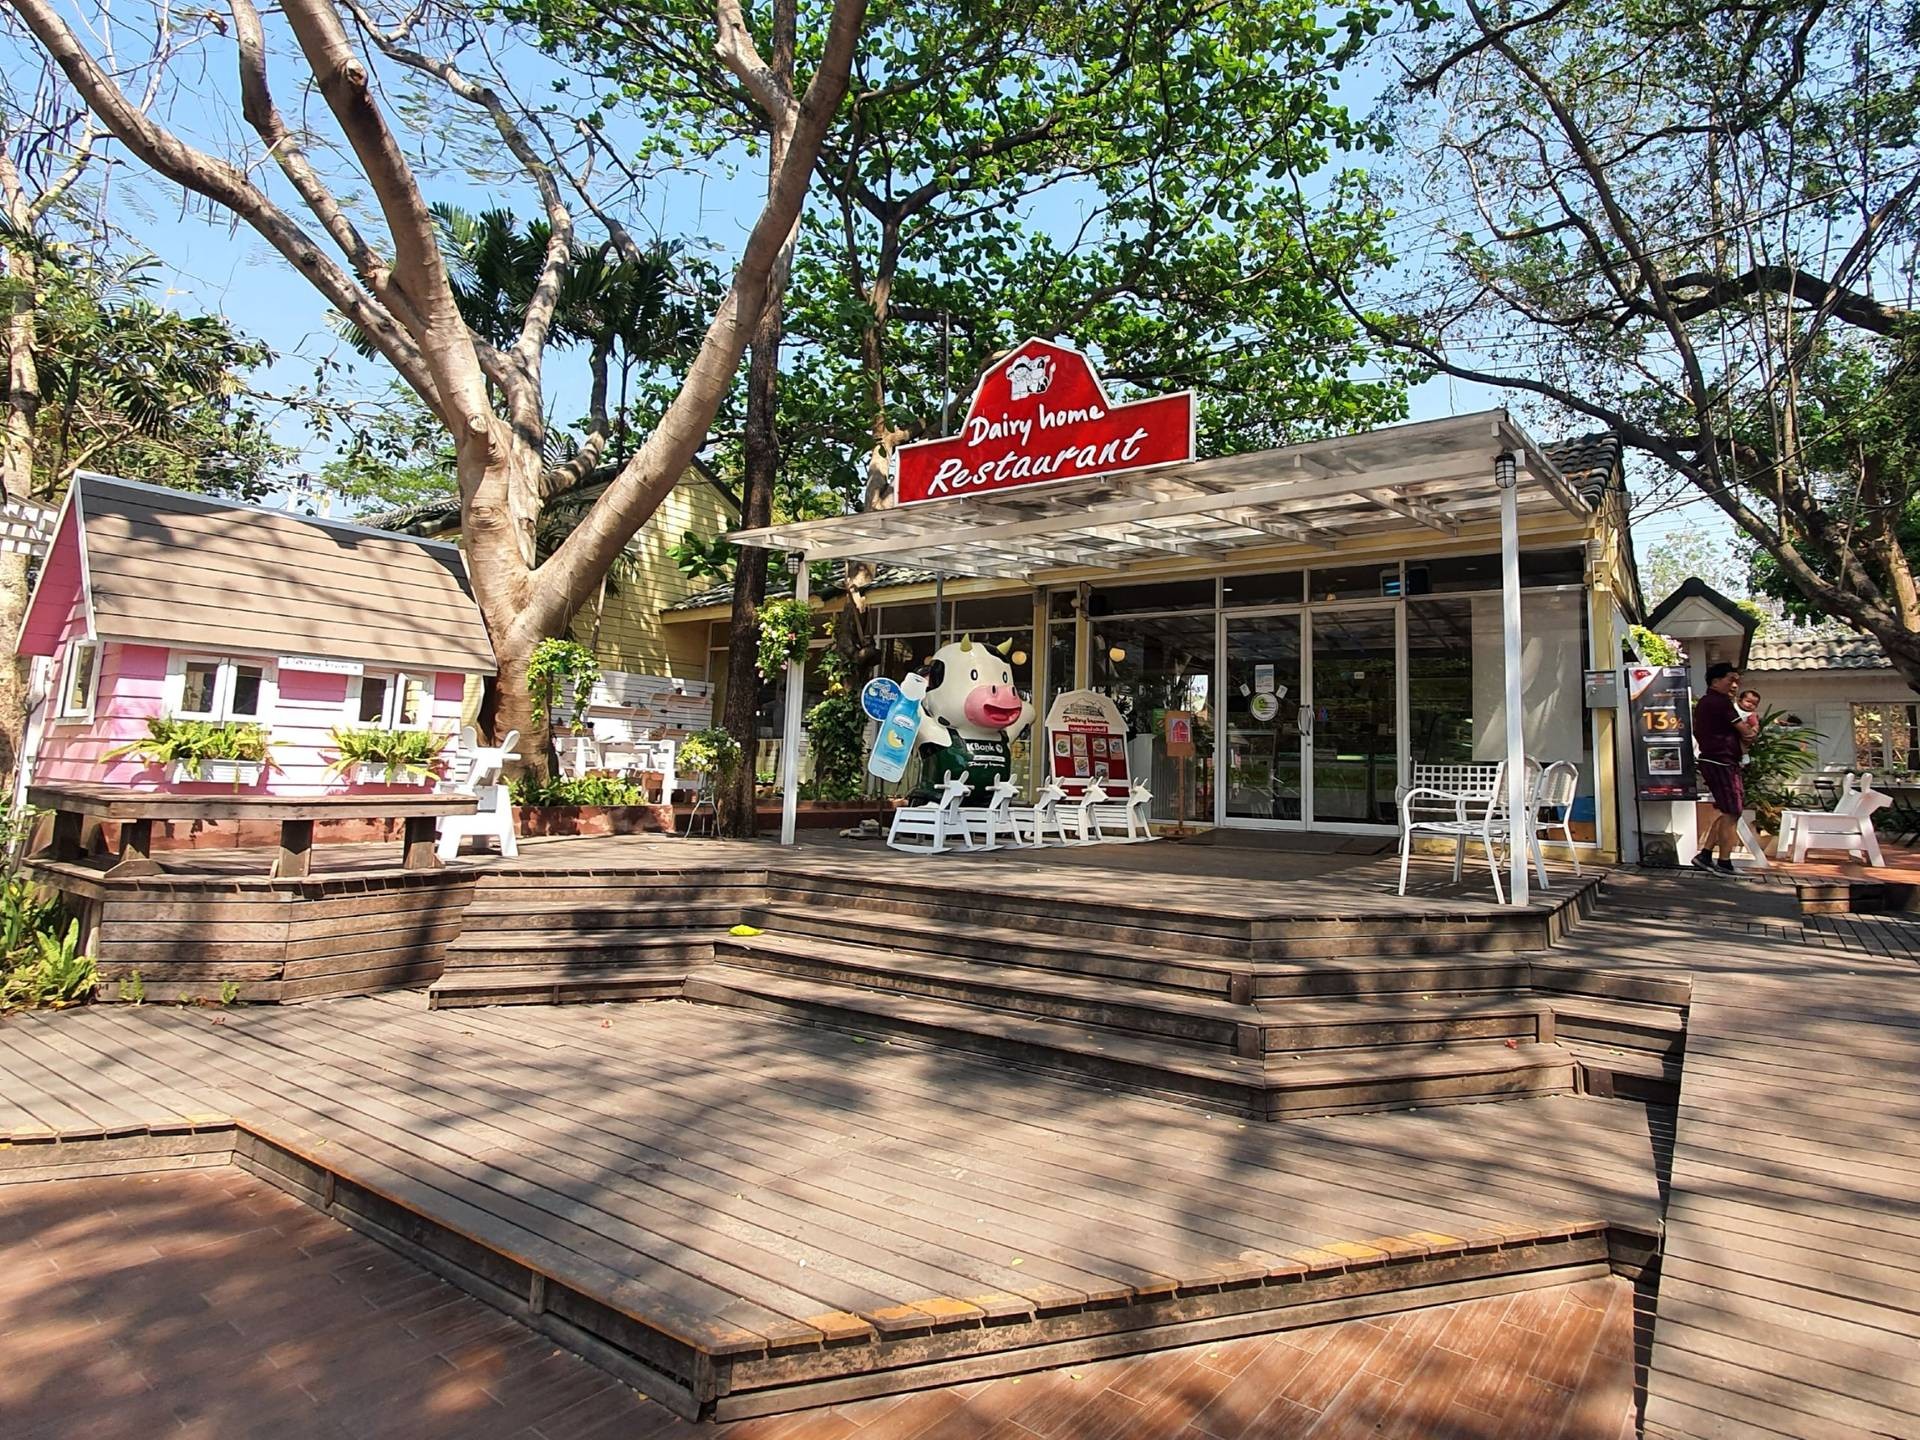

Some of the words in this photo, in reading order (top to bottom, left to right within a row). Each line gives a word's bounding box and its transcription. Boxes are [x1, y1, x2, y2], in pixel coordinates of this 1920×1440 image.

[968, 413, 1032, 447] Dairy
[1039, 403, 1106, 430] home
[927, 427, 1149, 496] Restaurant
[1642, 711, 1685, 731] 13%
